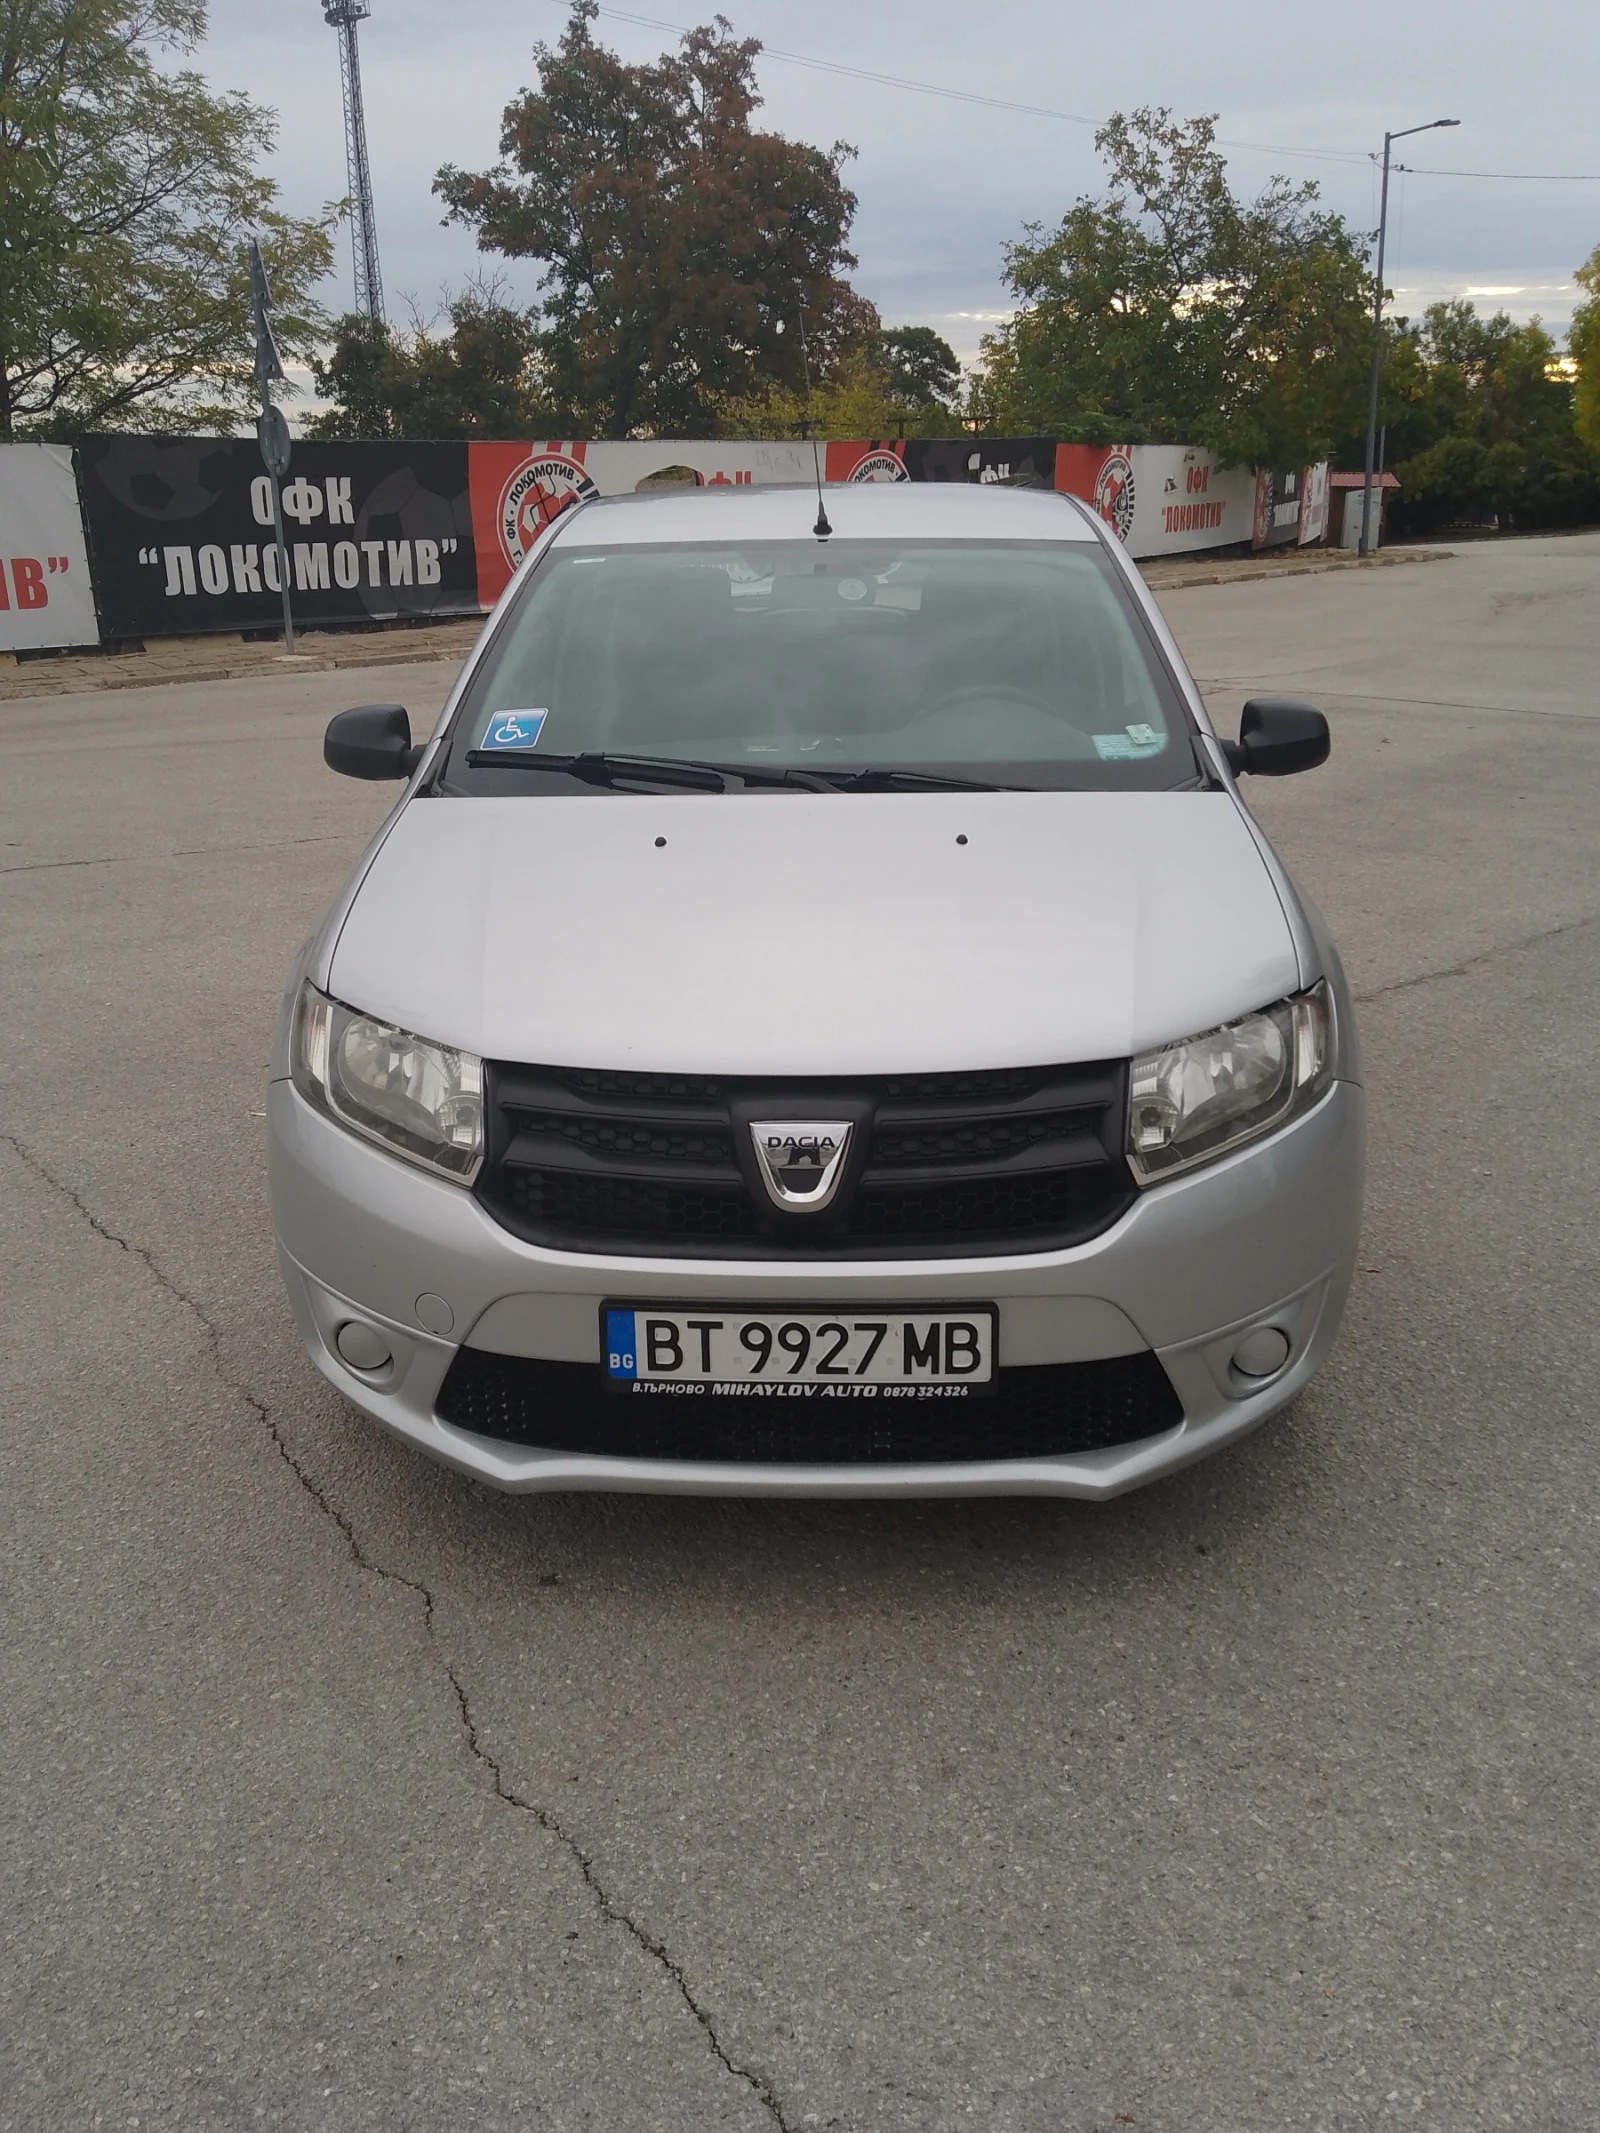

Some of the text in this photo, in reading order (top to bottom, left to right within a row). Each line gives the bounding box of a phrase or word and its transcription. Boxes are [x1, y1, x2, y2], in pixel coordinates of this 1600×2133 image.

[854, 458, 896, 482] ОКОМОТИВ
[1186, 466, 1209, 494] ОФК
[509, 463, 575, 506] ЛОКОМОТИВ
[250, 476, 355, 525] ОФК
[767, 1136, 835, 1149] DACIA
[608, 1353, 635, 1369] BG
[738, 1321, 888, 1375] 9927
[711, 1383, 818, 1397] MIHAYLOV
[820, 1385, 878, 1398] AUTO
[883, 1386, 916, 1398] 0878
